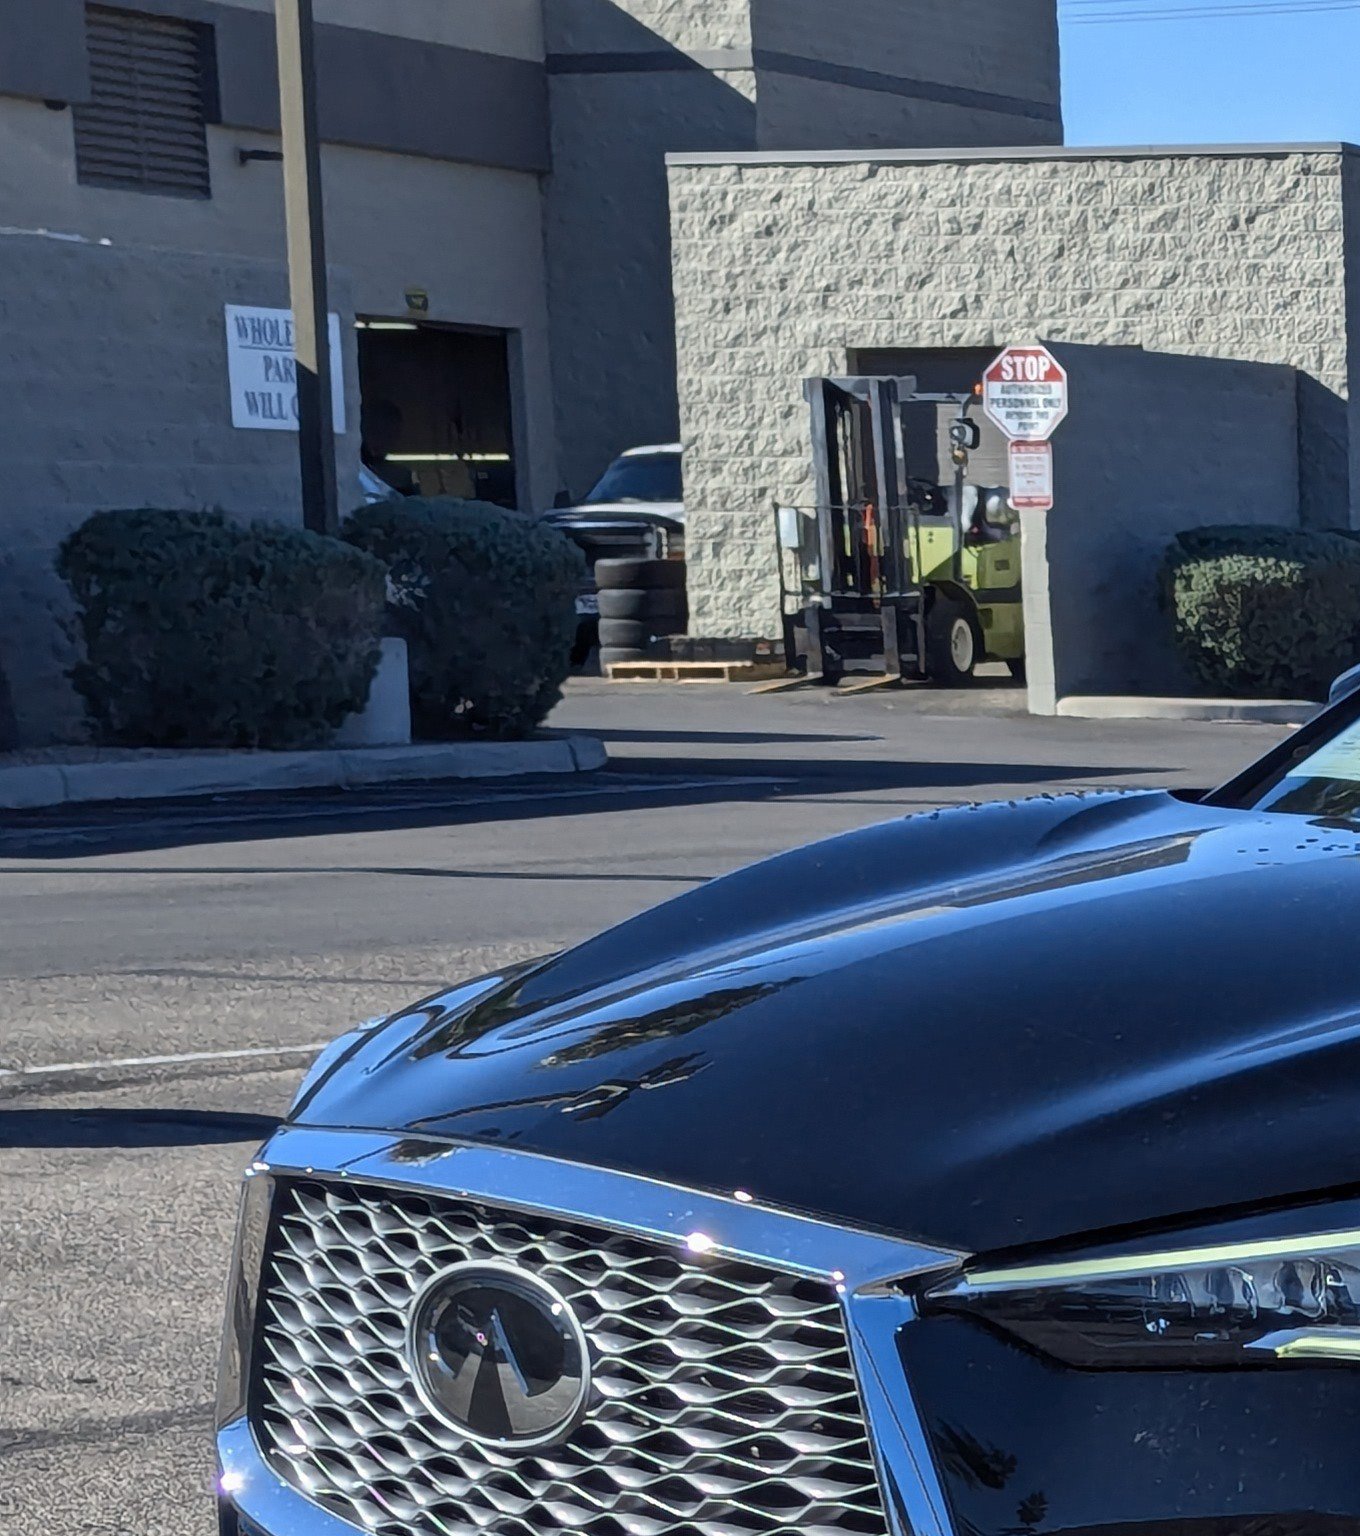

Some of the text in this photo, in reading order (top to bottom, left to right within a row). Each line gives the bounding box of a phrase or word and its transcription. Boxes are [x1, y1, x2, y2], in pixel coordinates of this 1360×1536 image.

[234, 315, 294, 347] WHOLE
[262, 354, 296, 384] PAR
[1001, 355, 1051, 381] STOP
[244, 390, 288, 420] WILL
[990, 397, 1040, 409] PERSONNEL
